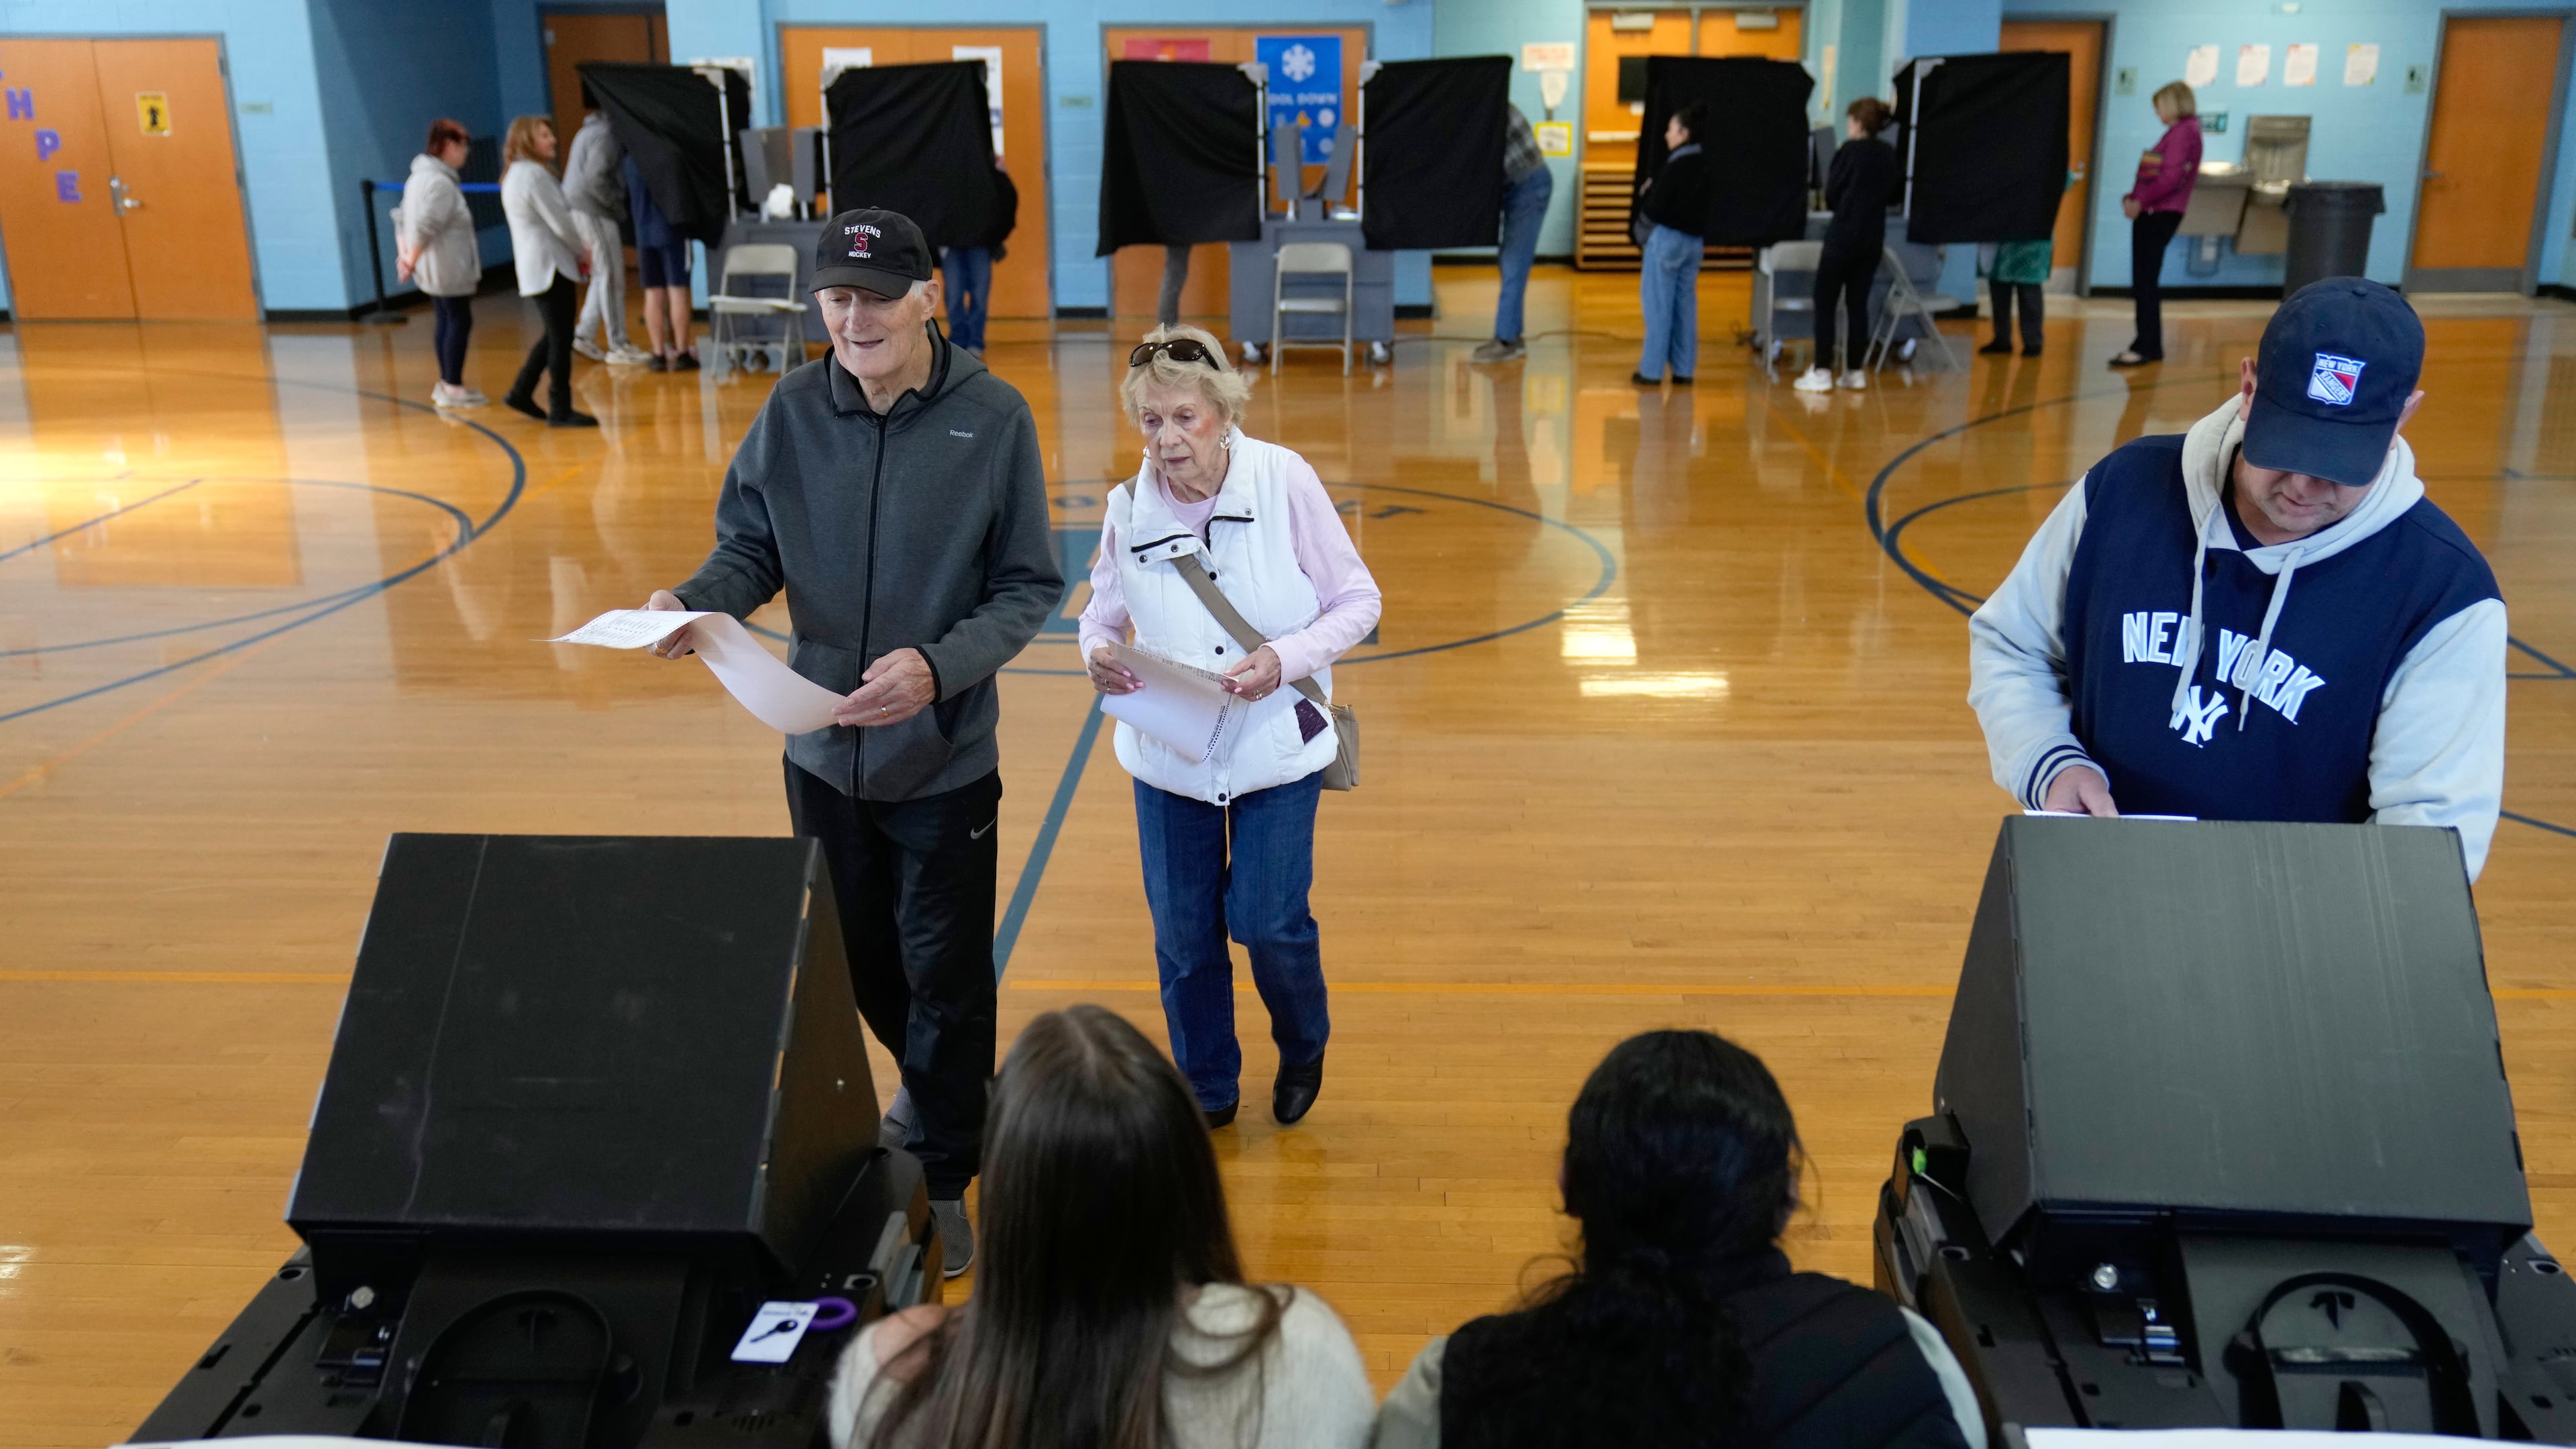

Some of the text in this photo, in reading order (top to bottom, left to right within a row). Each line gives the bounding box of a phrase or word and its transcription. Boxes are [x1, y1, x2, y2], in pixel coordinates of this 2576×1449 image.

[1296, 92, 1338, 105] DOWN
[844, 224, 881, 238] STEVENS
[854, 232, 869, 252] S
[2318, 358, 2358, 374] NEW YORK
[2319, 370, 2349, 401] RANGERS
[949, 429, 974, 438] Reebok
[2216, 628, 2326, 723] YORK
